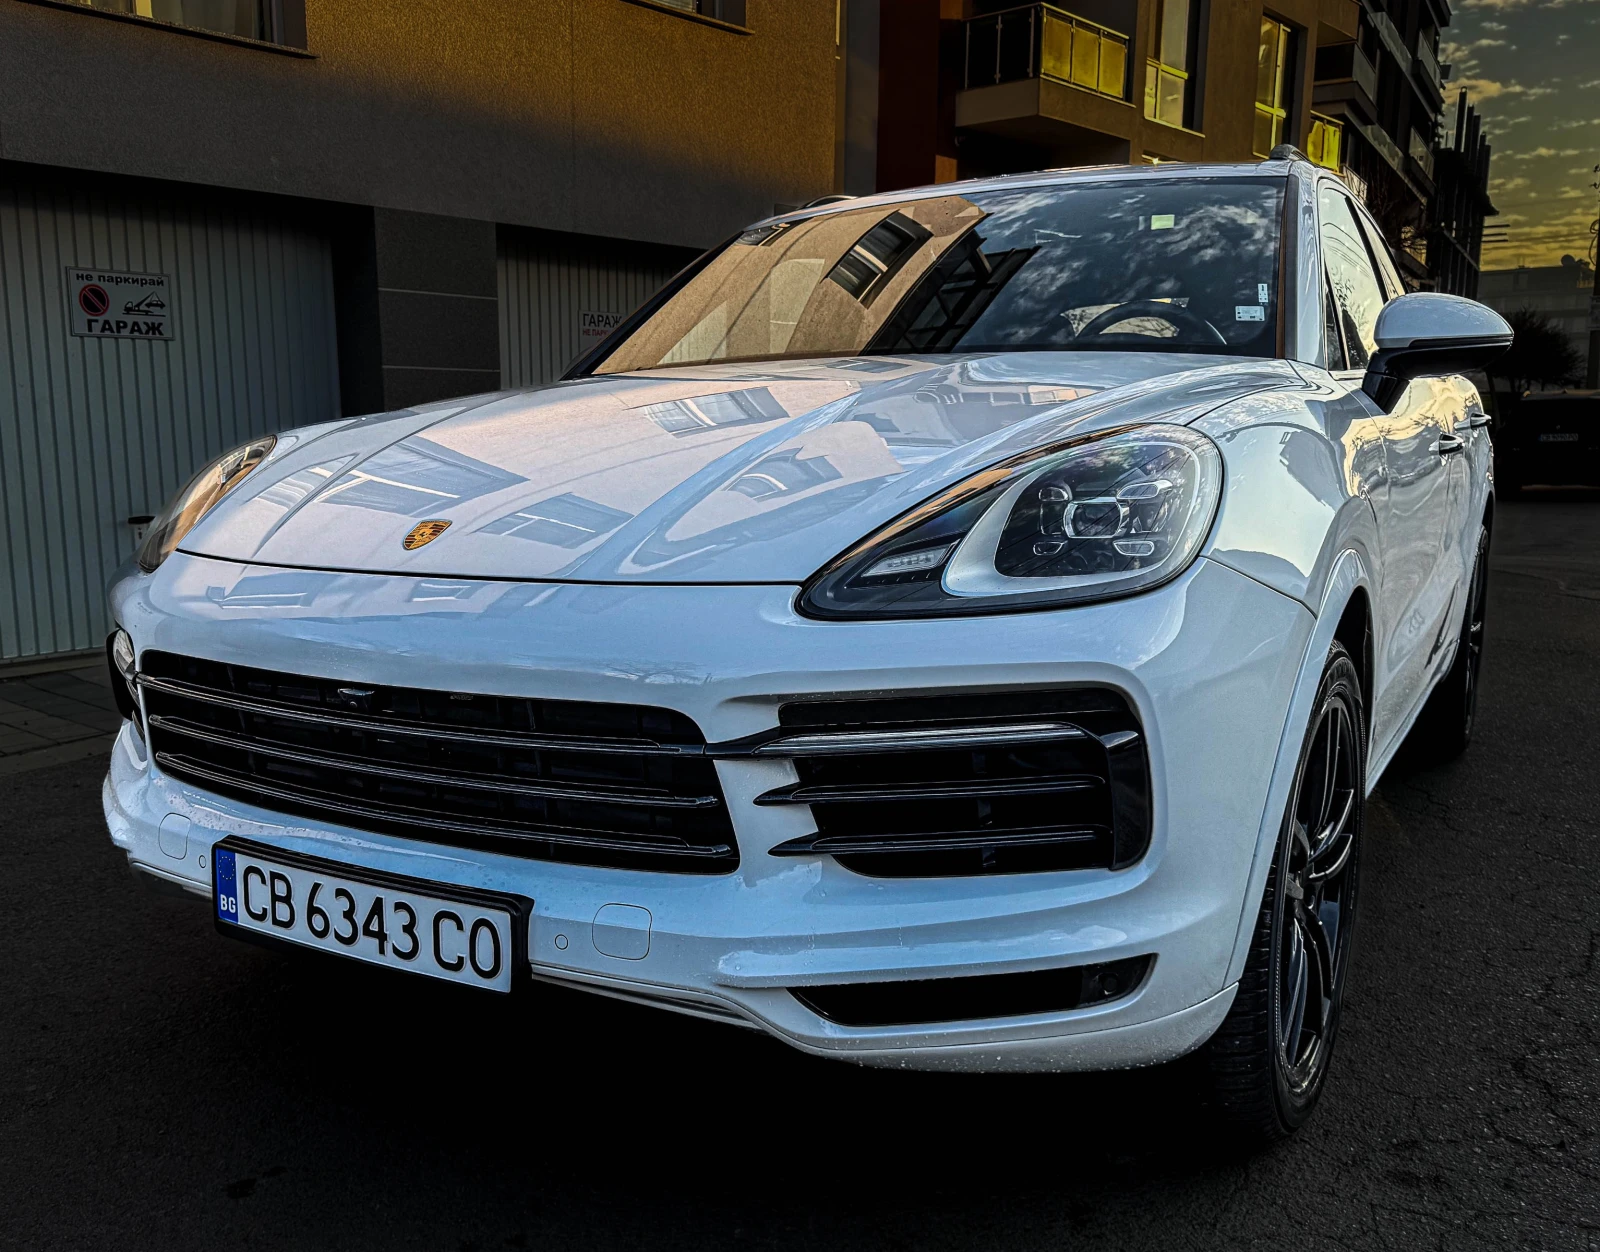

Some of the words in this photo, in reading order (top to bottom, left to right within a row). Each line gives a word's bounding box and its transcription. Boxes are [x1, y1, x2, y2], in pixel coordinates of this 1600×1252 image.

[76, 273, 93, 282] не
[98, 274, 165, 287] паркирай
[87, 319, 165, 336] ГАРАЖ
[220, 894, 236, 914] BG
[243, 865, 296, 929] CB
[306, 882, 420, 961] 6343
[432, 910, 502, 980] CO
